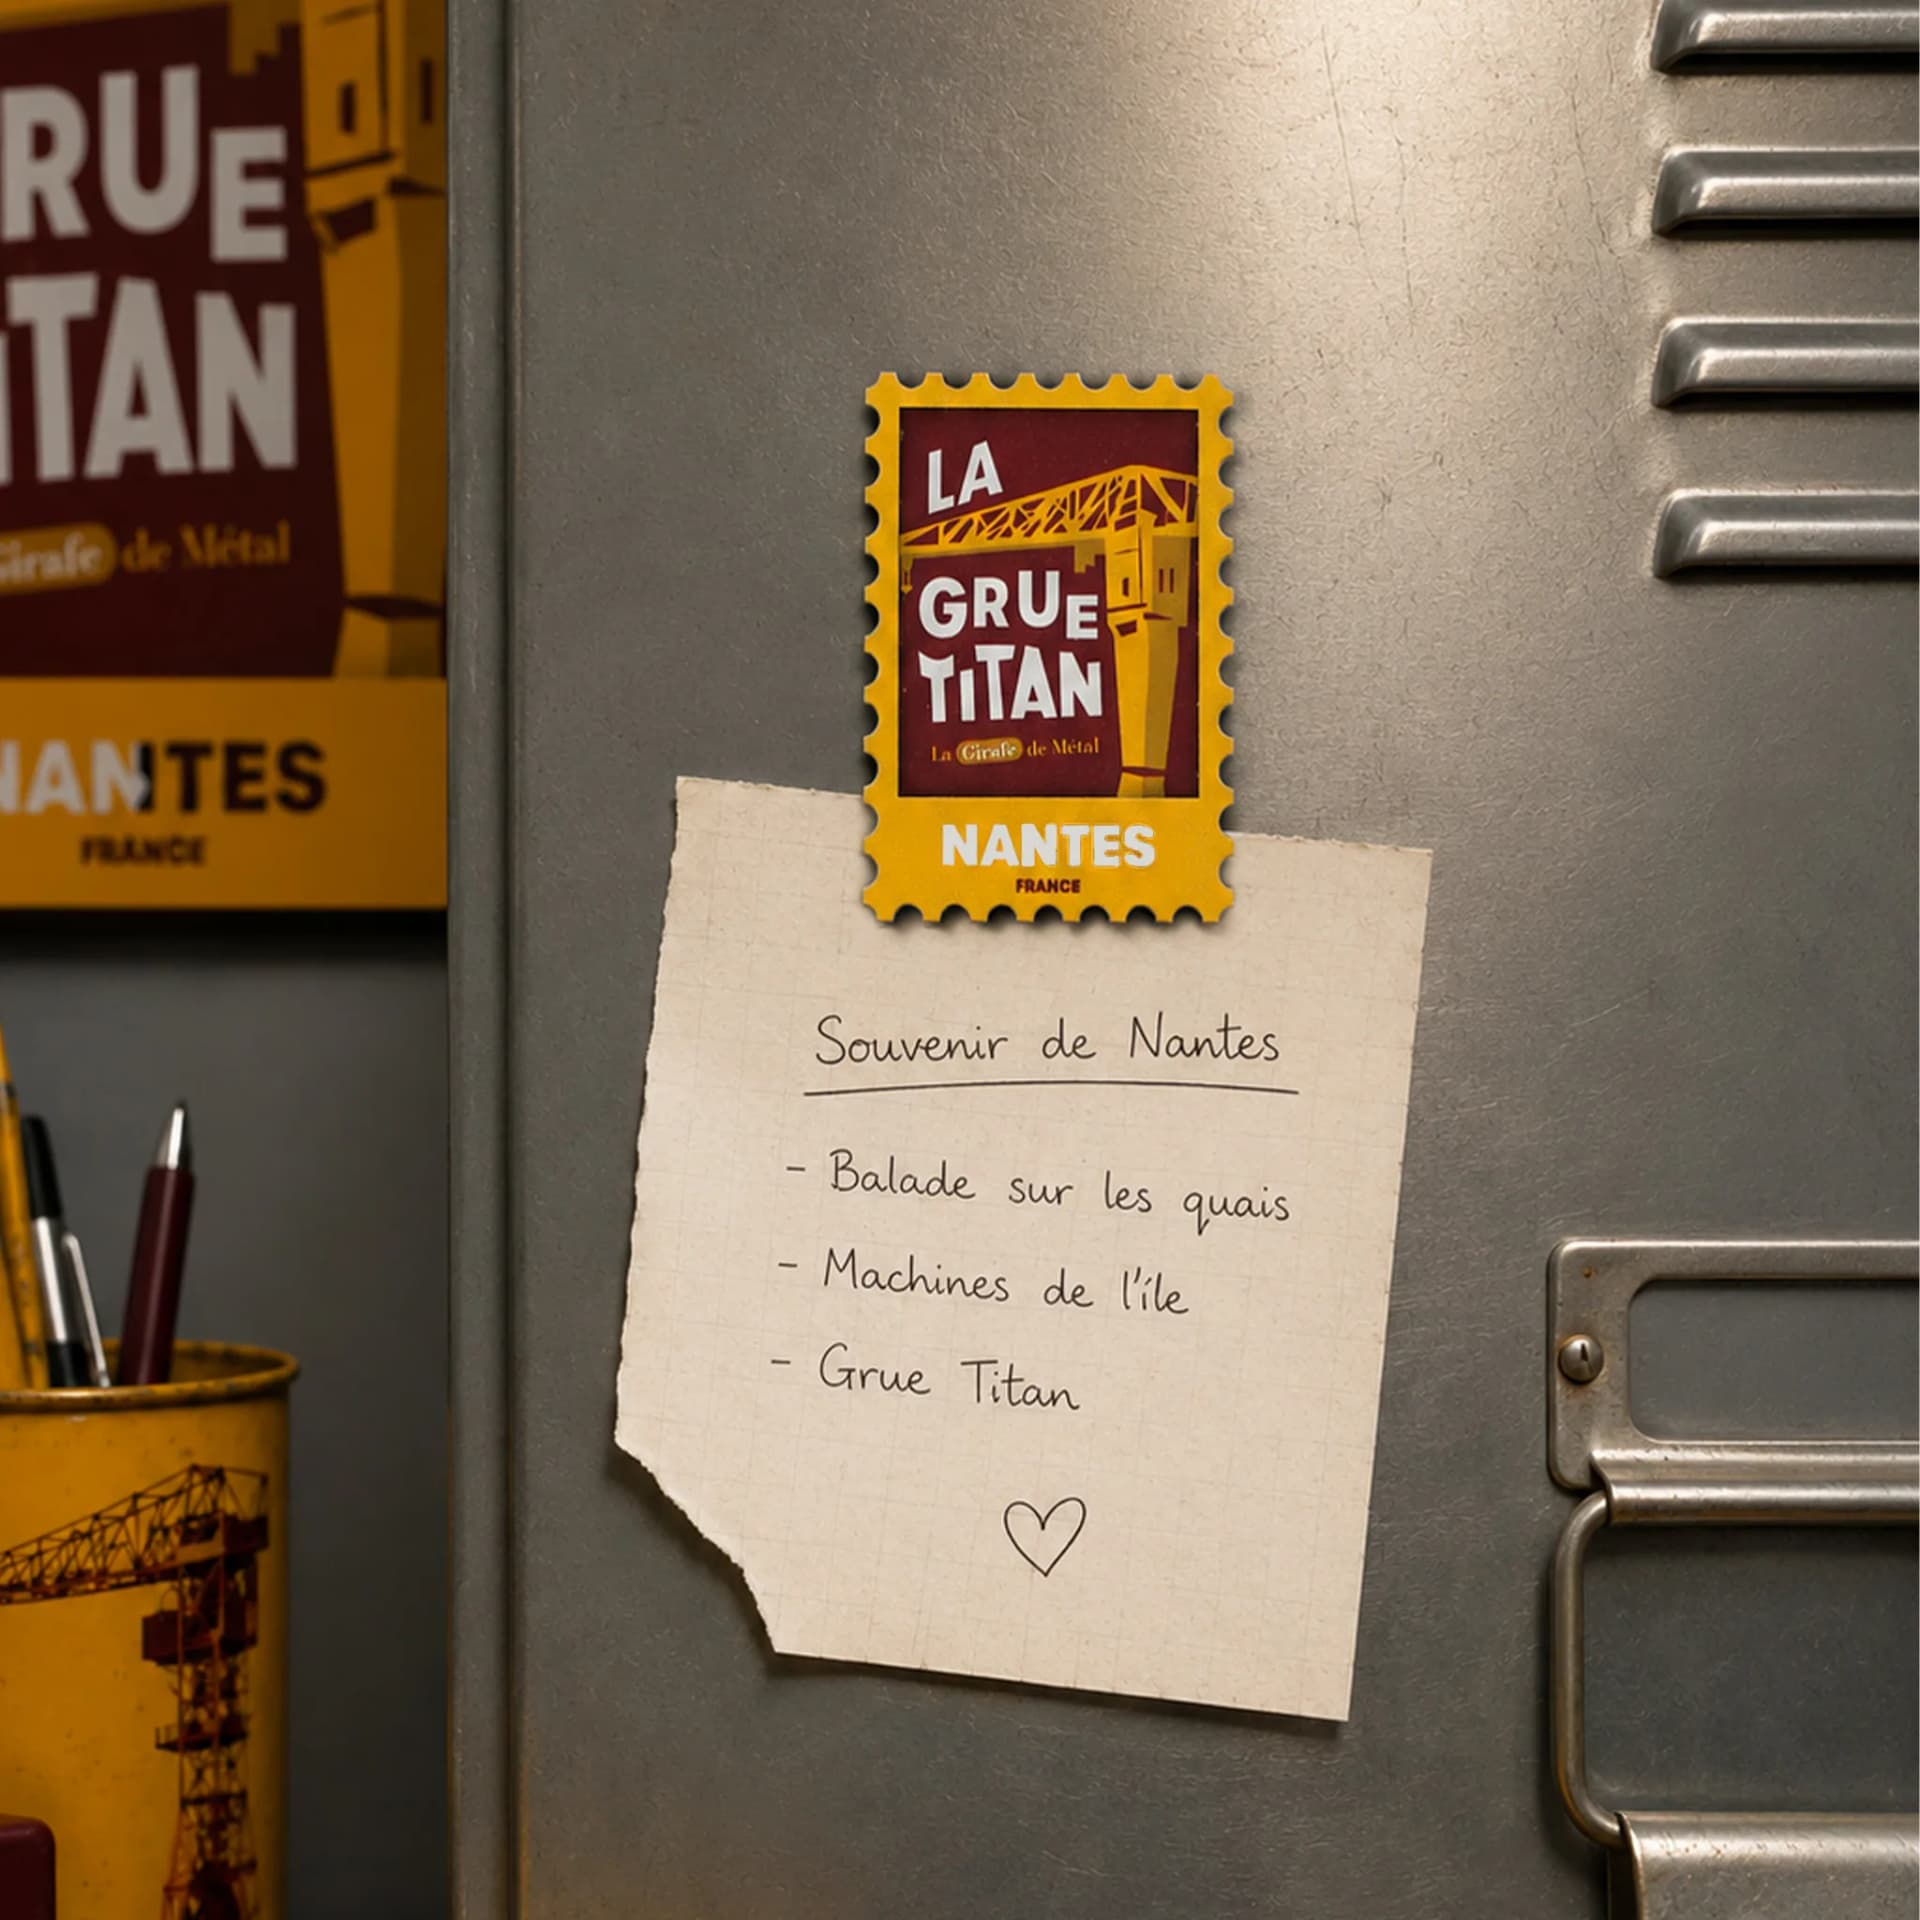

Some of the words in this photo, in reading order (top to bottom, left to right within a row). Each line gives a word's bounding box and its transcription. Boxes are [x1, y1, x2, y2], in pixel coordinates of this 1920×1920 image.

[928, 440, 1003, 515] LA
[0, 531, 102, 584] irafe
[122, 527, 171, 573] de
[180, 520, 291, 569] Métal
[918, 570, 1099, 640] GRUE
[918, 644, 1103, 723] TITAN
[931, 745, 952, 762] La
[961, 741, 1017, 761] Girafe
[1027, 740, 1047, 757] de
[1052, 735, 1099, 756] Métal
[80, 834, 207, 867] FRANCE
[942, 823, 1156, 868] NANTES
[1015, 878, 1081, 894] FRANCE
[815, 1014, 1009, 1065] Souvenir
[1041, 1017, 1097, 1060] de
[1129, 1010, 1280, 1062] Nantes
[829, 1148, 977, 1200] Balade
[1008, 1176, 1074, 1205] sur
[1104, 1170, 1152, 1213] les
[1183, 1186, 1290, 1236] quais
[823, 1247, 1009, 1303] Machines
[1043, 1267, 1094, 1308] de
[819, 1342, 931, 1395] Grue
[960, 1359, 1080, 1411] Titan
